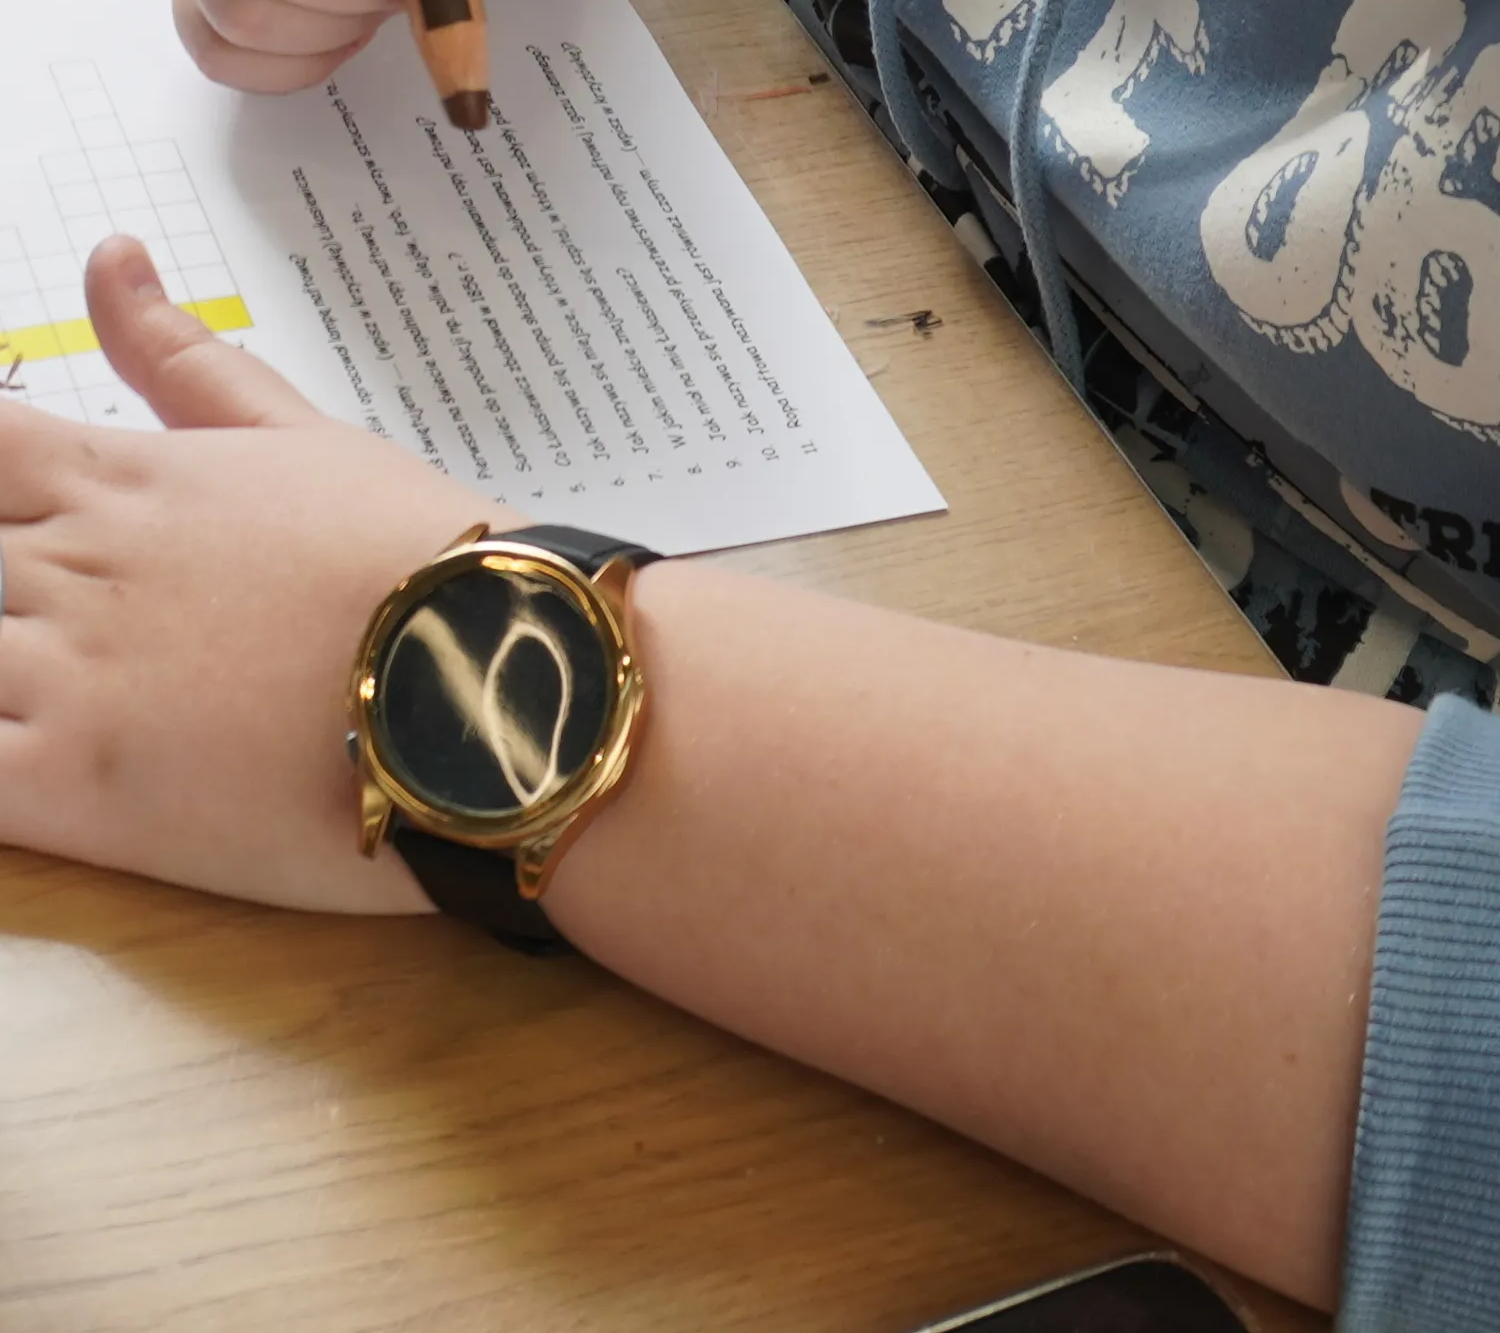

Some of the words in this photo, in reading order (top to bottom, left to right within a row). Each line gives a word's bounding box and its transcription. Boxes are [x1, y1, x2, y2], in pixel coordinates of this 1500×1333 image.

[577, 130, 616, 182] naftowej
[490, 178, 543, 255] produkowana
[637, 168, 675, 215] czarnym
[461, 196, 511, 266] pompowania
[398, 306, 433, 359] kopalnia
[666, 287, 715, 343] przemysł
[710, 286, 753, 345] nazywana
[453, 335, 498, 397] produkcji
[480, 316, 523, 374] zbudował
[530, 326, 566, 369] pompa
[744, 344, 784, 397] naftowa
[513, 374, 564, 451] Łukasiewicz
[562, 387, 598, 436] nazywa
[600, 381, 636, 430] nazywa
[714, 362, 750, 410] nazywa
[455, 422, 494, 482] Pierwsza
[493, 414, 534, 474] Surowiec
